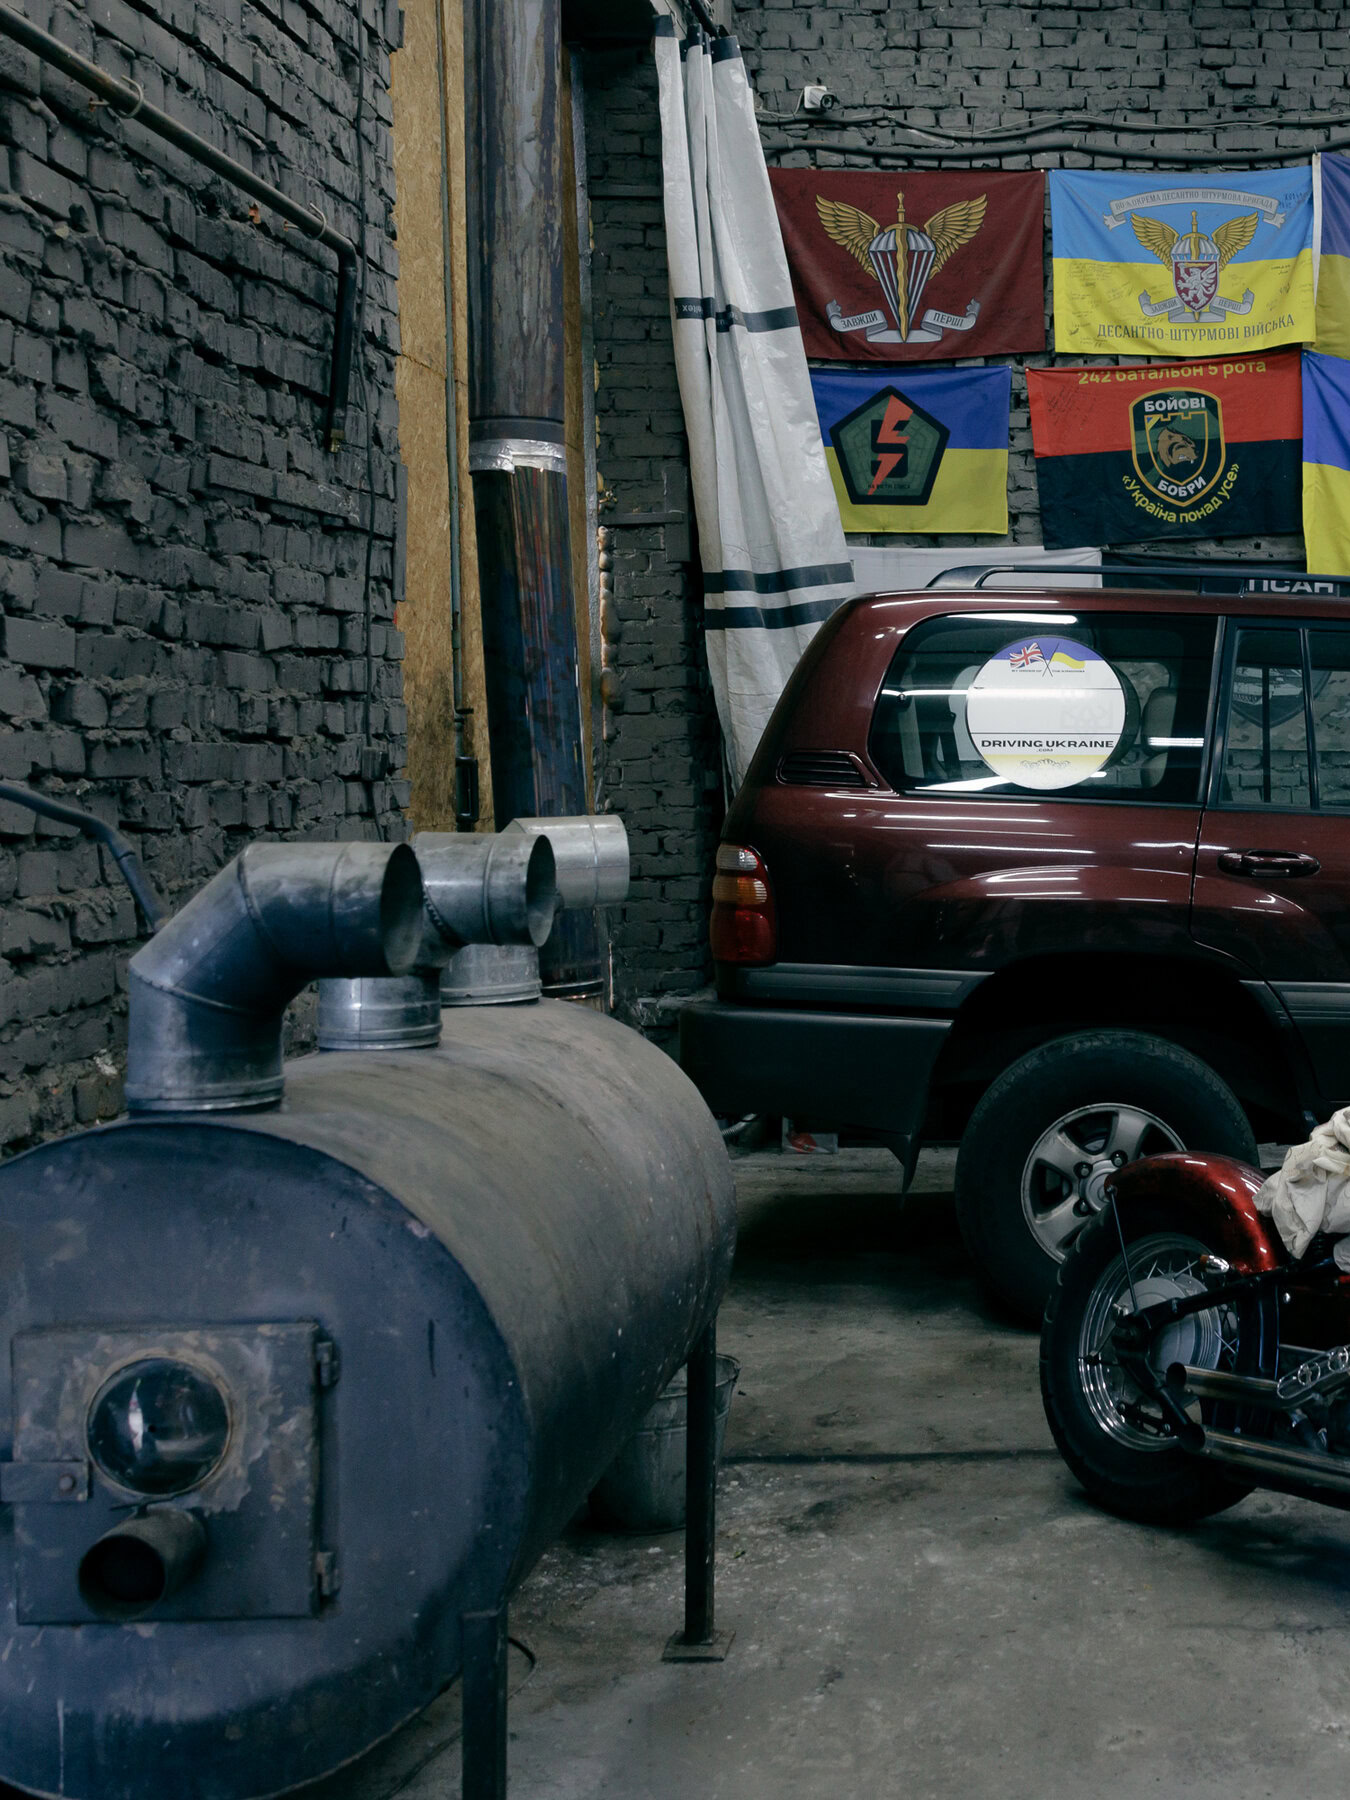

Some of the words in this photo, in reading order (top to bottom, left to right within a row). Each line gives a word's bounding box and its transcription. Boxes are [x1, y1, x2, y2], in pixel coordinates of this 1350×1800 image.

[1132, 196, 1161, 206] ОКРЕМА
[1162, 190, 1241, 202] ДЕСАНТНО-ШТУРМОВА
[1242, 196, 1274, 209] БРИГАДА
[840, 312, 878, 329] ЗАВЖДИ
[932, 312, 964, 327] ПЕРШІ
[1097, 324, 1239, 342] ДЕСАНТНО-ШТУРМОВІ
[1243, 313, 1295, 339] ВІЙСЬКА
[1078, 370, 1111, 385] 242
[1223, 361, 1266, 378] рота
[1144, 396, 1205, 412] БОЙОВІ
[1122, 474, 1177, 523] «Україна
[1179, 496, 1223, 523] понад
[1217, 463, 1240, 500] усе»
[1158, 476, 1207, 497] БОБРИ
